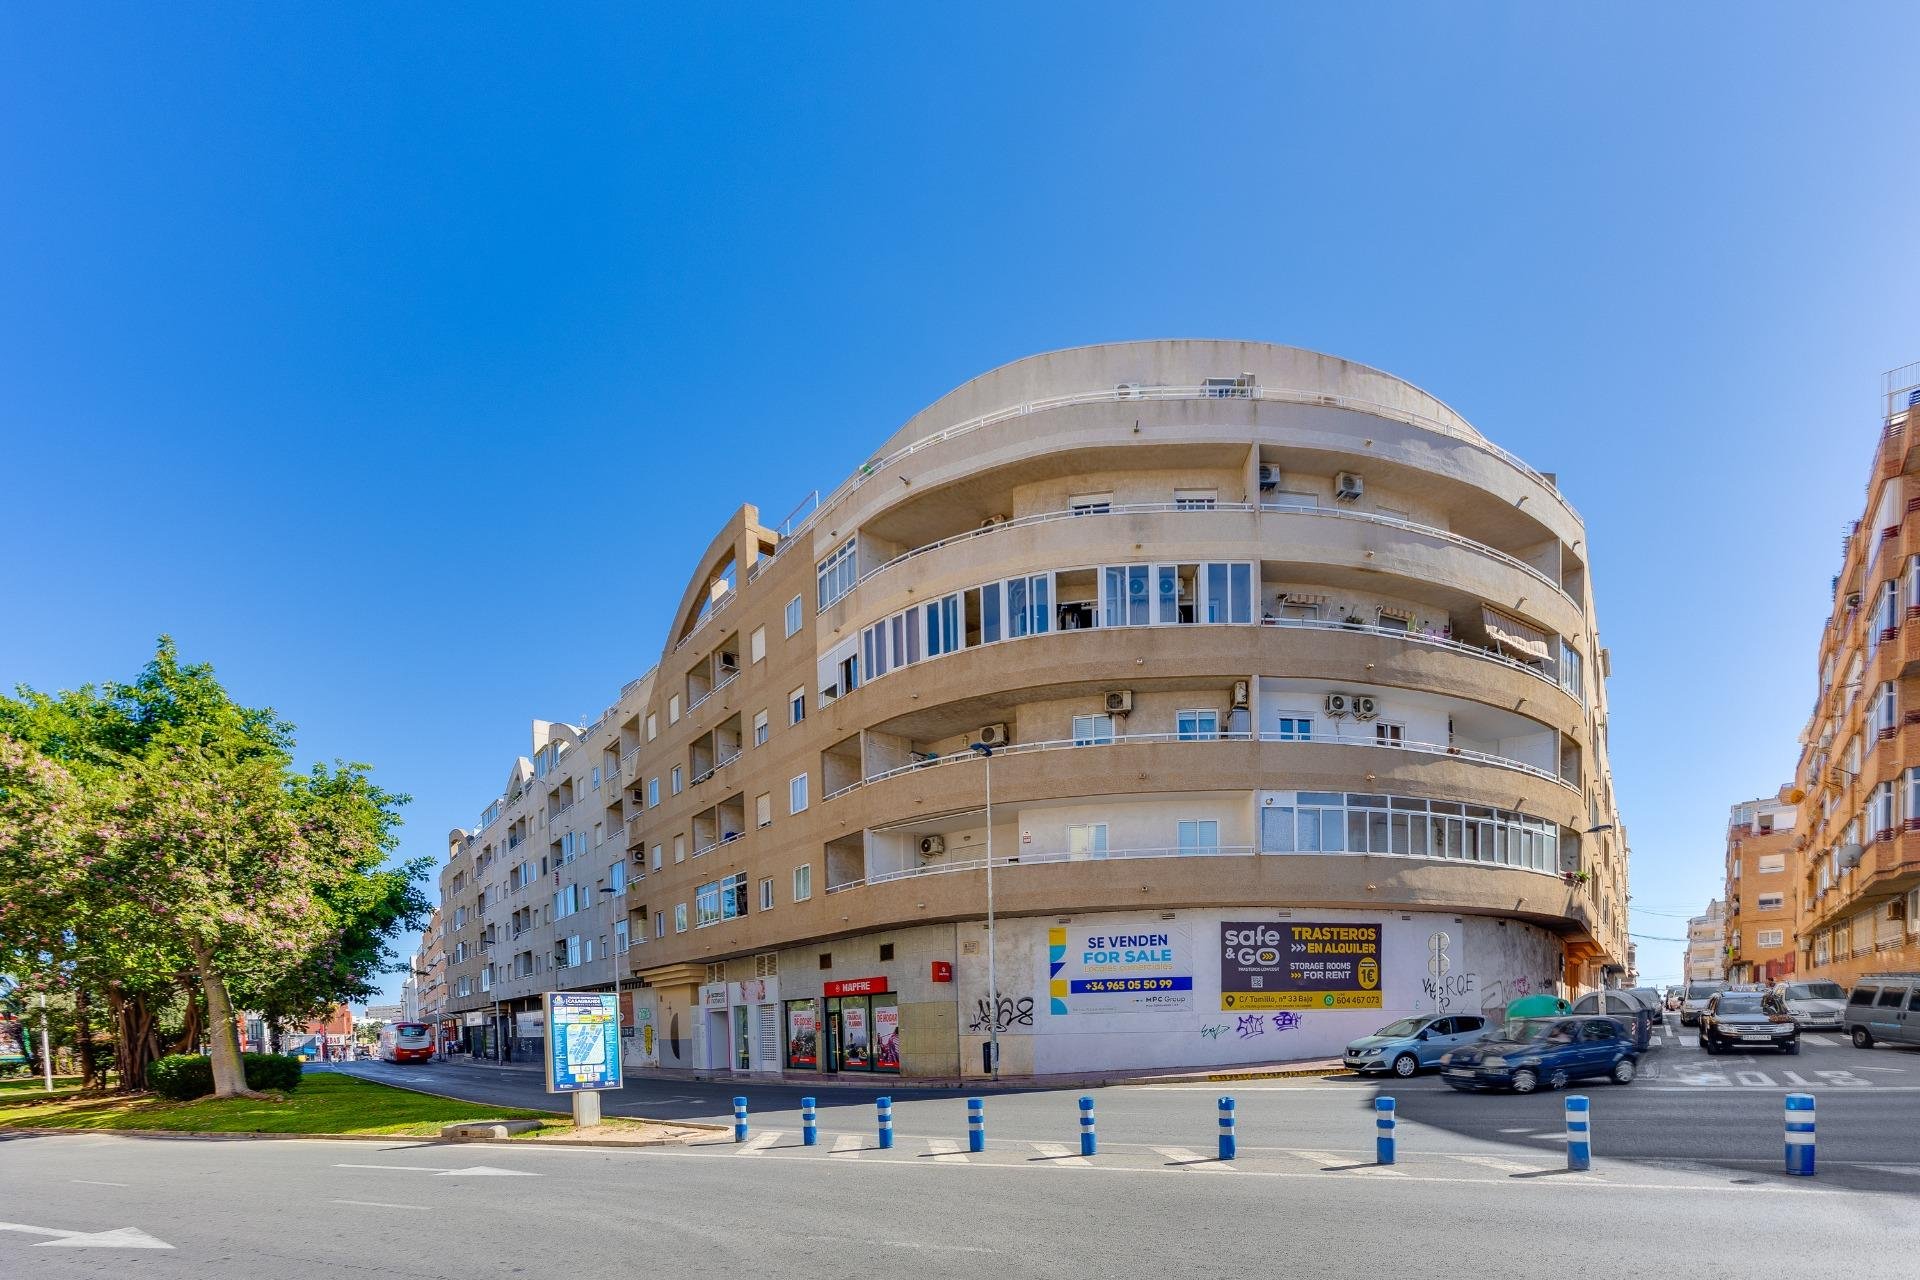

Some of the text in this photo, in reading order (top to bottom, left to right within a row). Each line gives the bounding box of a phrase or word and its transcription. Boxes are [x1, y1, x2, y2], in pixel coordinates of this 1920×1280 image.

[1225, 925, 1280, 946] safe
[1291, 927, 1376, 941] TRASTEROS
[1088, 934, 1168, 949] SE VENDEN
[1307, 943, 1376, 954] EN ALQUILER
[1083, 949, 1172, 964] FOR SALE
[1225, 947, 1280, 965] & GO
[1083, 962, 1173, 973] Locales comerciales
[1290, 962, 1325, 970] STORAGE
[1326, 962, 1351, 970] ROOMS
[1303, 971, 1351, 979] FOR RENT
[1361, 969, 1375, 983] 1€
[842, 981, 871, 992] MAPFRE
[1085, 979, 1173, 991] +34 965 05 50 99
[1164, 996, 1186, 1004] Group
[1287, 995, 1298, 1003] 33
[1298, 995, 1313, 1004] Bajo
[1337, 996, 1380, 1005] 604 467 073
